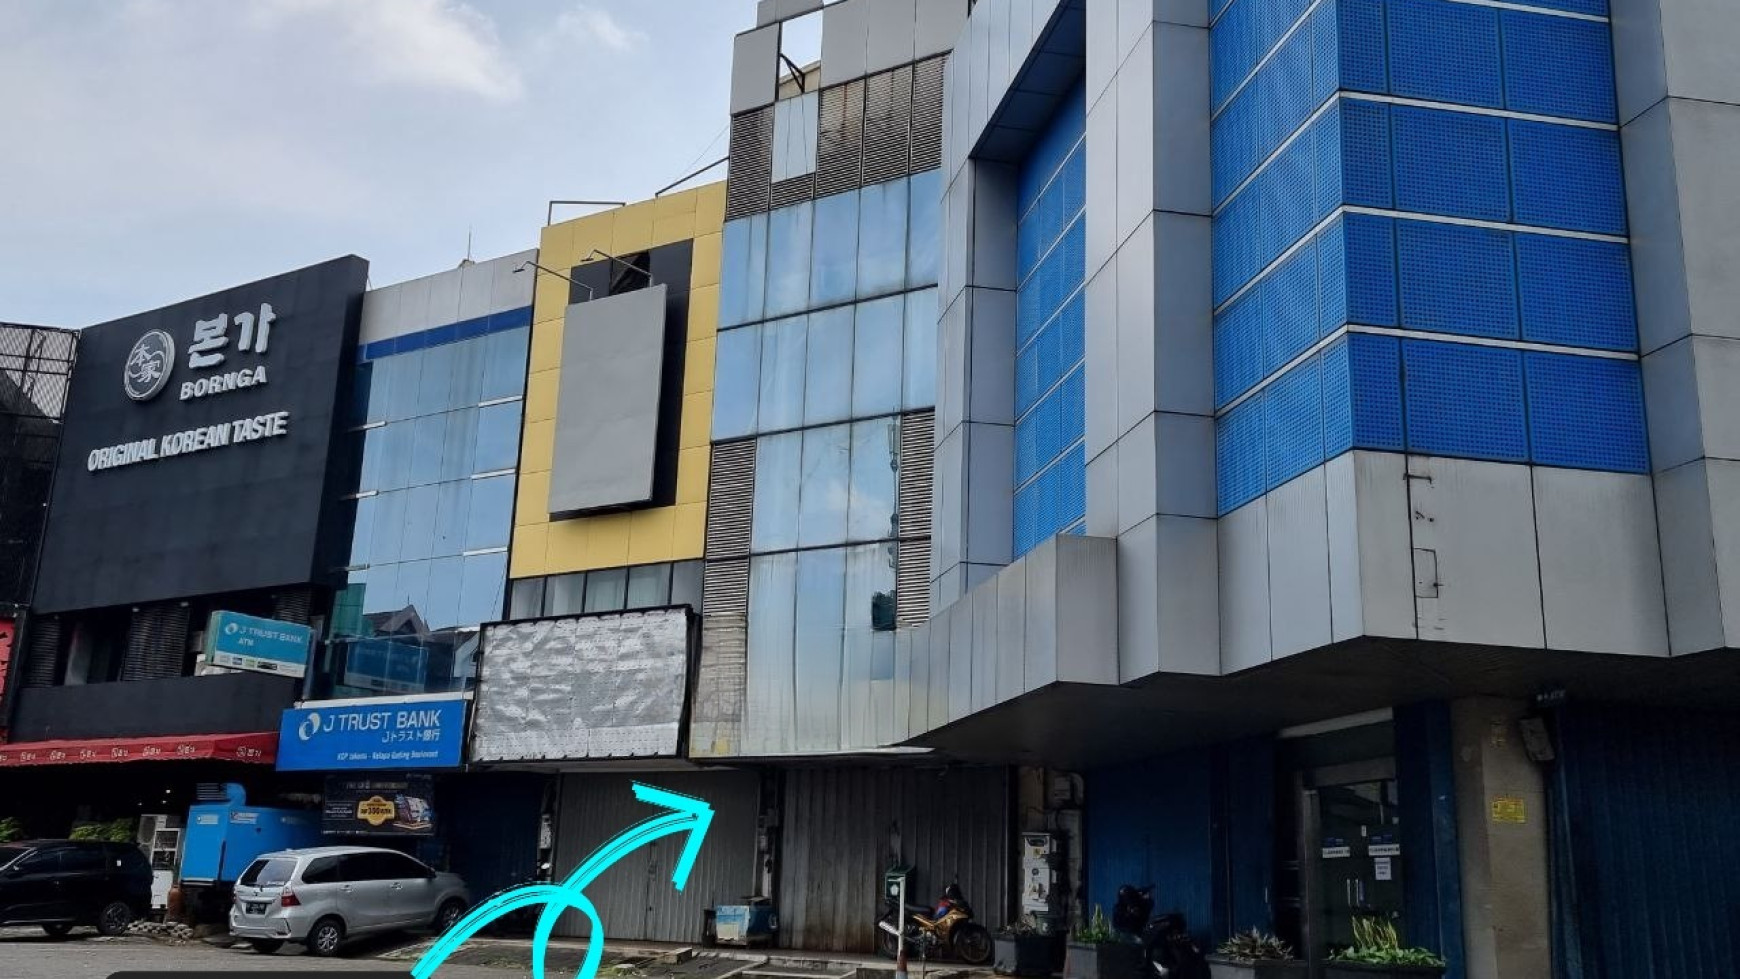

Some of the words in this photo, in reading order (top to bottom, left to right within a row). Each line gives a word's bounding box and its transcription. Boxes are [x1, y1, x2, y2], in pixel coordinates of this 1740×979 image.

[188, 303, 276, 369] 본가
[180, 365, 268, 400] BORNGA
[87, 438, 160, 471] ORIGINAL
[160, 422, 231, 457] KOREAN
[232, 411, 290, 443] TASTE
[238, 637, 254, 647] ATM
[239, 626, 246, 634] J
[249, 627, 279, 639] TRUST
[280, 632, 303, 643] BANK
[323, 714, 335, 732] J
[338, 711, 392, 731] TRUST
[396, 709, 442, 728] BANK
